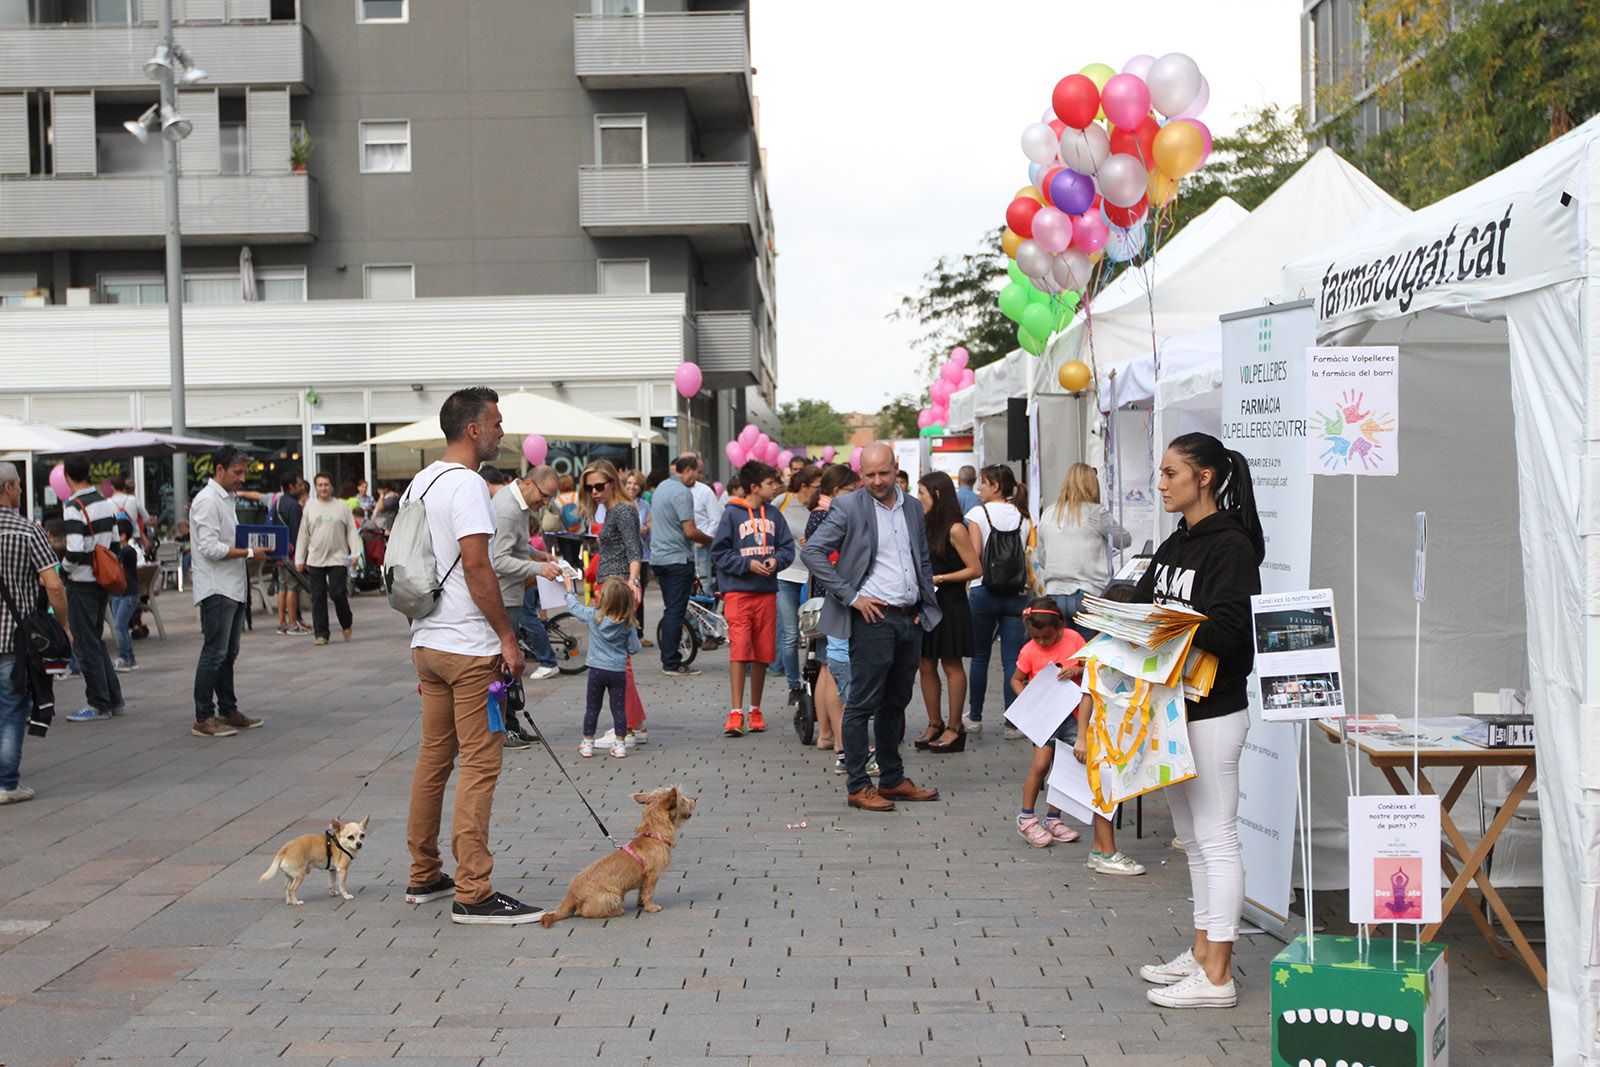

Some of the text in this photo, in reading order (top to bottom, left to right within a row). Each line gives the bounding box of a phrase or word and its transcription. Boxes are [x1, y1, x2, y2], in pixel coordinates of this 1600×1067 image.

[1320, 203, 1514, 321] farmacugat.cat
[1313, 354, 1395, 364] Farmàcia Volpelleres
[1240, 361, 1288, 384] VOLPELLERES
[1322, 369, 1356, 377] farmàcia
[1358, 369, 1371, 377] del
[1373, 369, 1393, 377] barri
[1240, 394, 1281, 415] FARMÀCIA
[1222, 421, 1272, 439] OLPELLERES
[1247, 458, 1261, 467] ORARI
[1409, 802, 1417, 810] el
[1393, 813, 1425, 821] programa
[1377, 822, 1386, 830] de
[1388, 822, 1407, 831] punts
